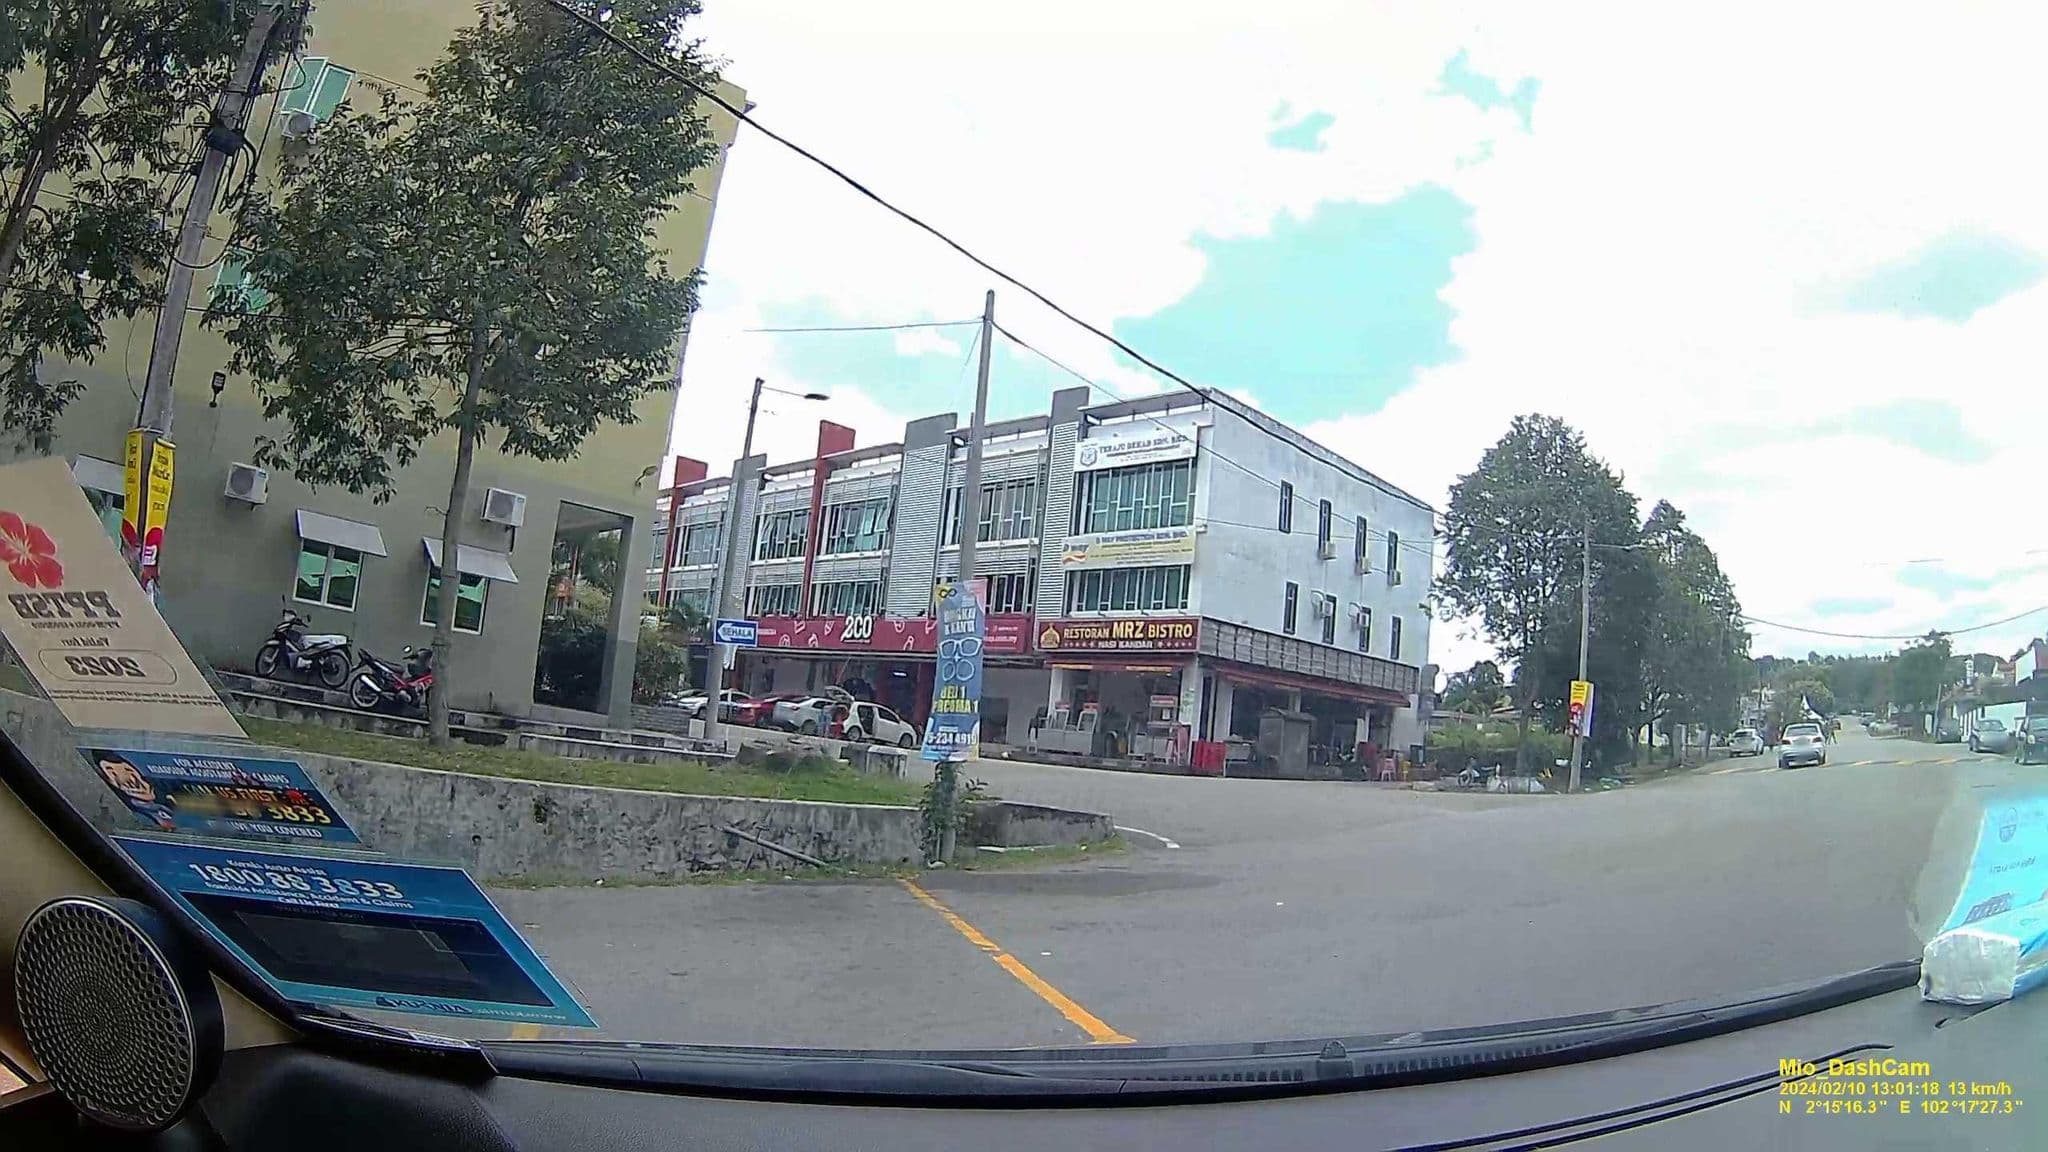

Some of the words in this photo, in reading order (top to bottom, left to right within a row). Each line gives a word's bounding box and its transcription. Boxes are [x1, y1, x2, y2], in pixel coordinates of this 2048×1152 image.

[1063, 627, 1110, 639] RESTORAN
[1111, 621, 1146, 639] MRZ
[1148, 623, 1193, 639] BISTRO
[1098, 640, 1117, 649] NASI
[1118, 640, 1153, 649] KANDAR
[173, 757, 193, 768] FOR
[292, 865, 327, 876] Assist
[189, 863, 264, 887] 1800
[265, 871, 312, 892] 88
[312, 875, 404, 900] 3833
[371, 899, 414, 909] Claims
